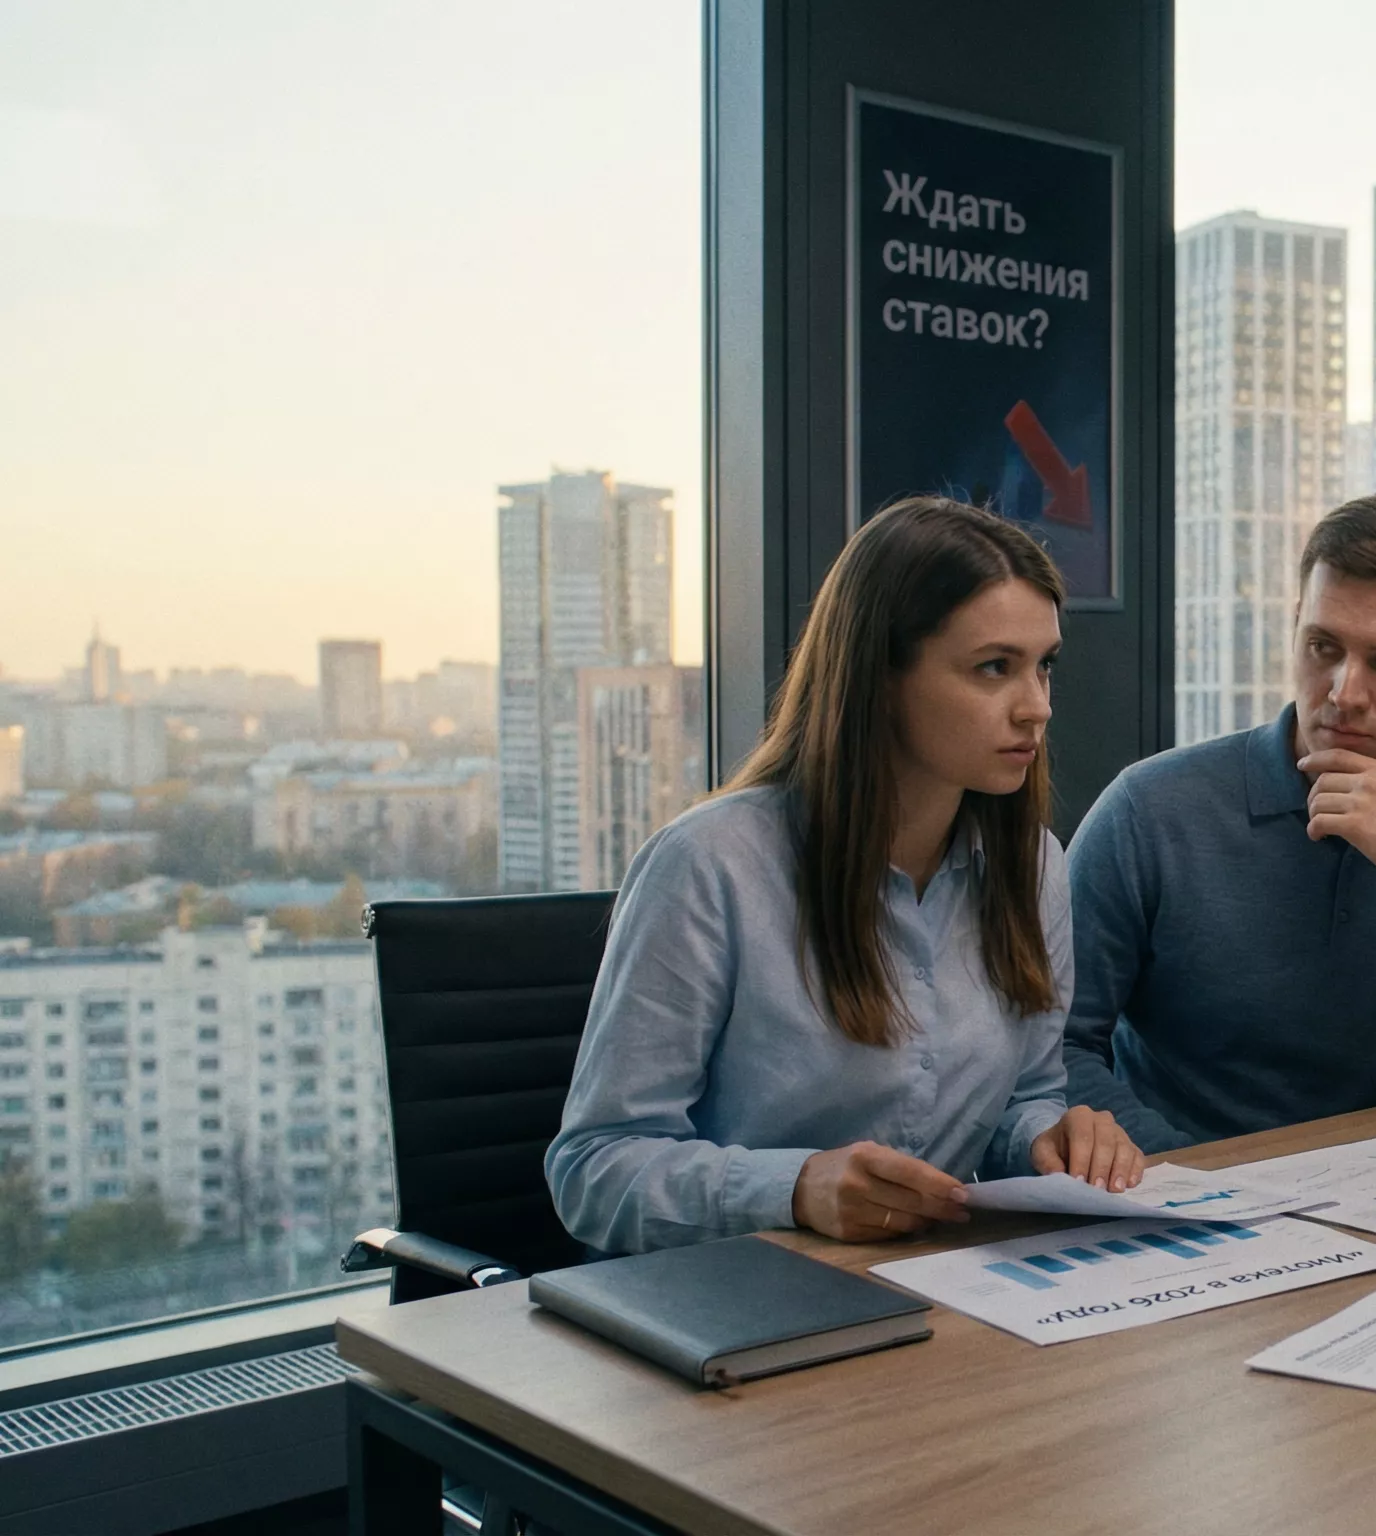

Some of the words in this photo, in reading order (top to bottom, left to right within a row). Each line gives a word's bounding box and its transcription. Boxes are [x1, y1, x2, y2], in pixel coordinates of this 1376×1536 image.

[882, 169, 1026, 234] Ждать
[882, 239, 1089, 301] снижения
[882, 298, 1049, 349] ставок?
[1128, 1284, 1206, 1308] 2026
[1207, 1279, 1228, 1289] в
